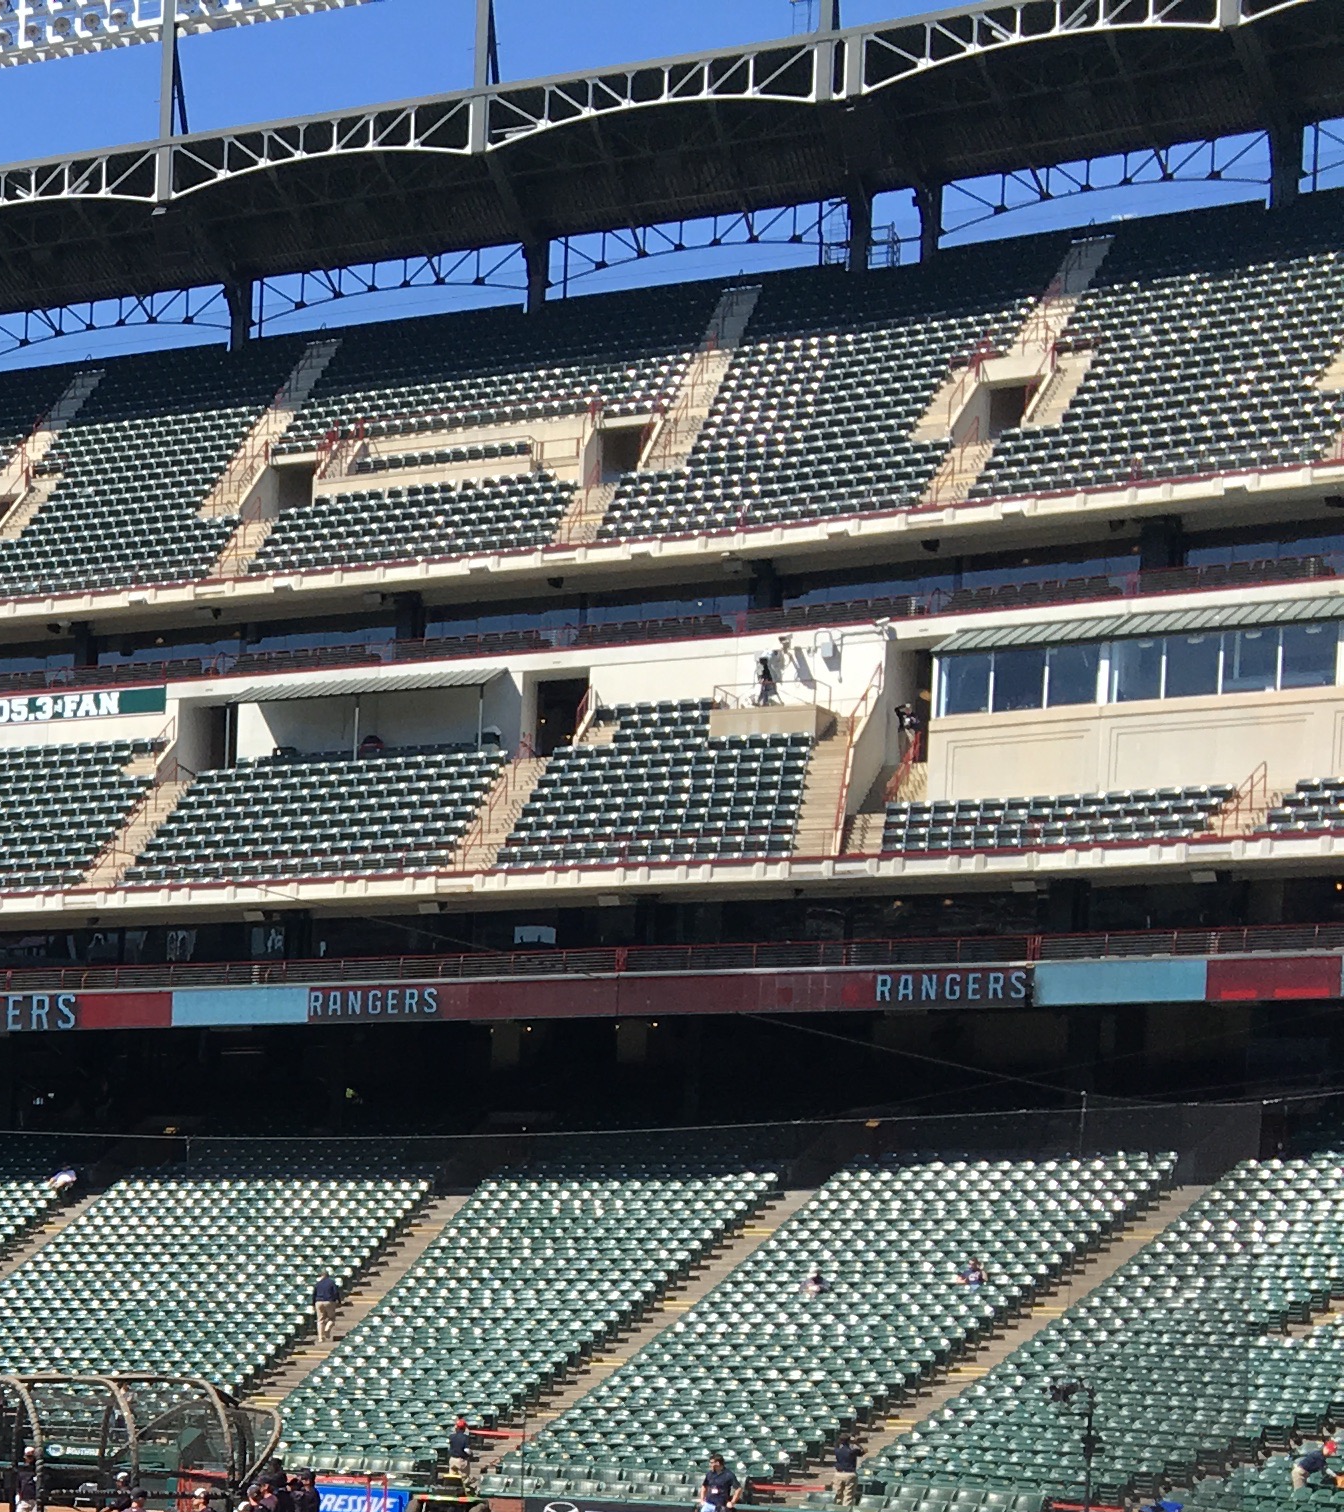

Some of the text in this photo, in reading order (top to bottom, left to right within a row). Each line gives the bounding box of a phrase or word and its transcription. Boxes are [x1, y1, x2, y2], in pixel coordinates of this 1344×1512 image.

[62, 691, 120, 718] FAN
[875, 969, 1027, 1002] RANGERS
[309, 988, 438, 1017] RANGERS
